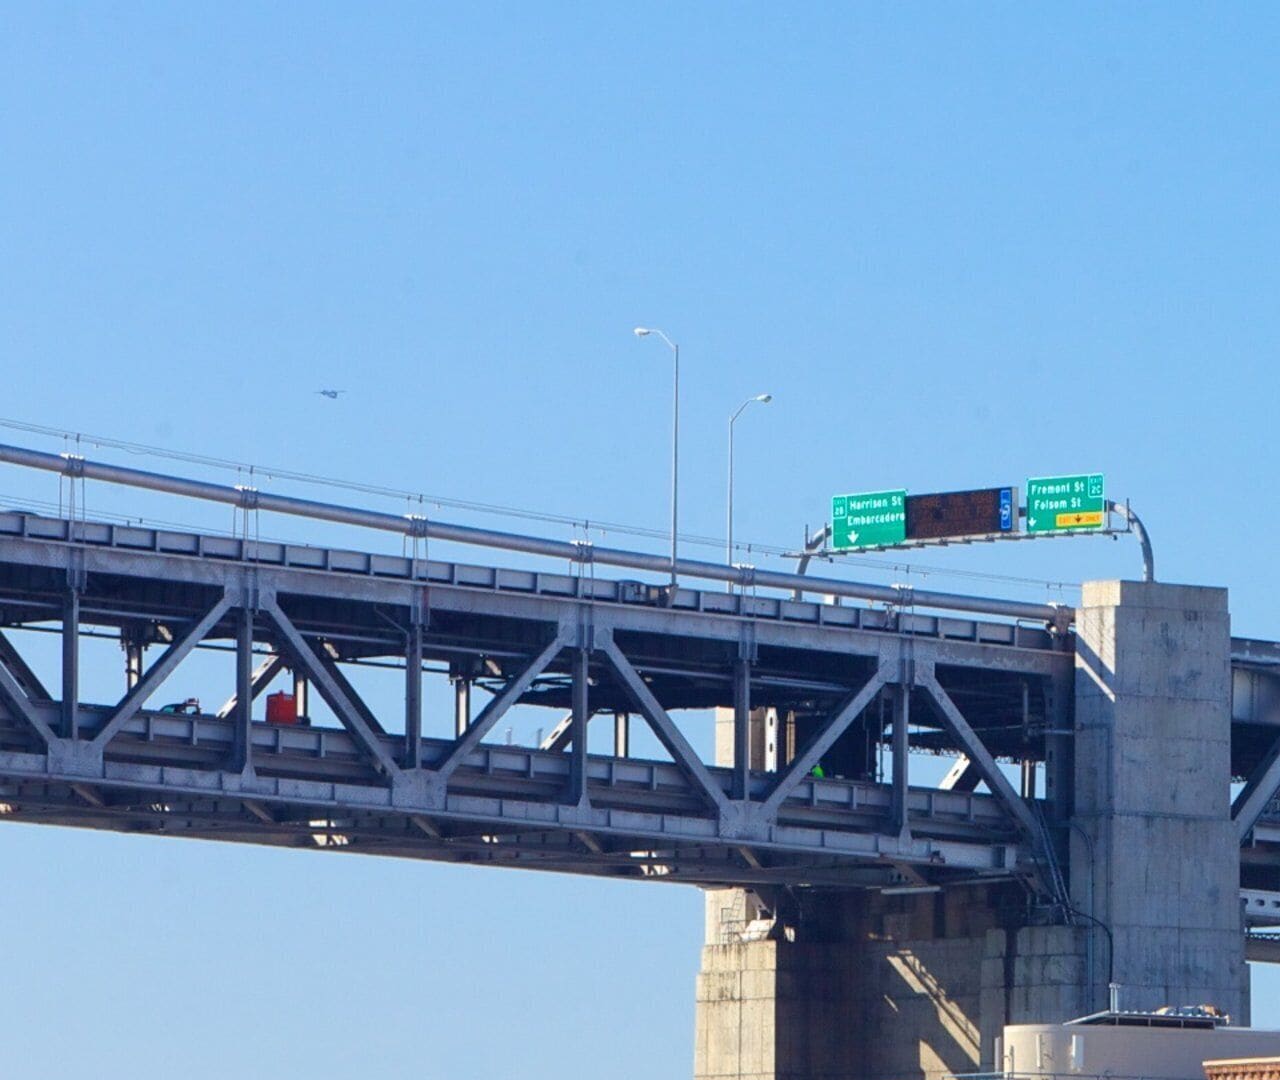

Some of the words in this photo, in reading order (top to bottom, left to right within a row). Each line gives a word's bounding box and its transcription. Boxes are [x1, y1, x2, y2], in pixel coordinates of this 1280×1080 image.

[1031, 482, 1070, 495] Fremont
[1074, 481, 1085, 493] St
[1091, 485, 1101, 494] 2C
[849, 498, 888, 510] Harrison
[891, 495, 902, 506] St
[1034, 499, 1067, 510] Folsom
[1071, 497, 1081, 508] St
[847, 512, 905, 526] Embarcadero
